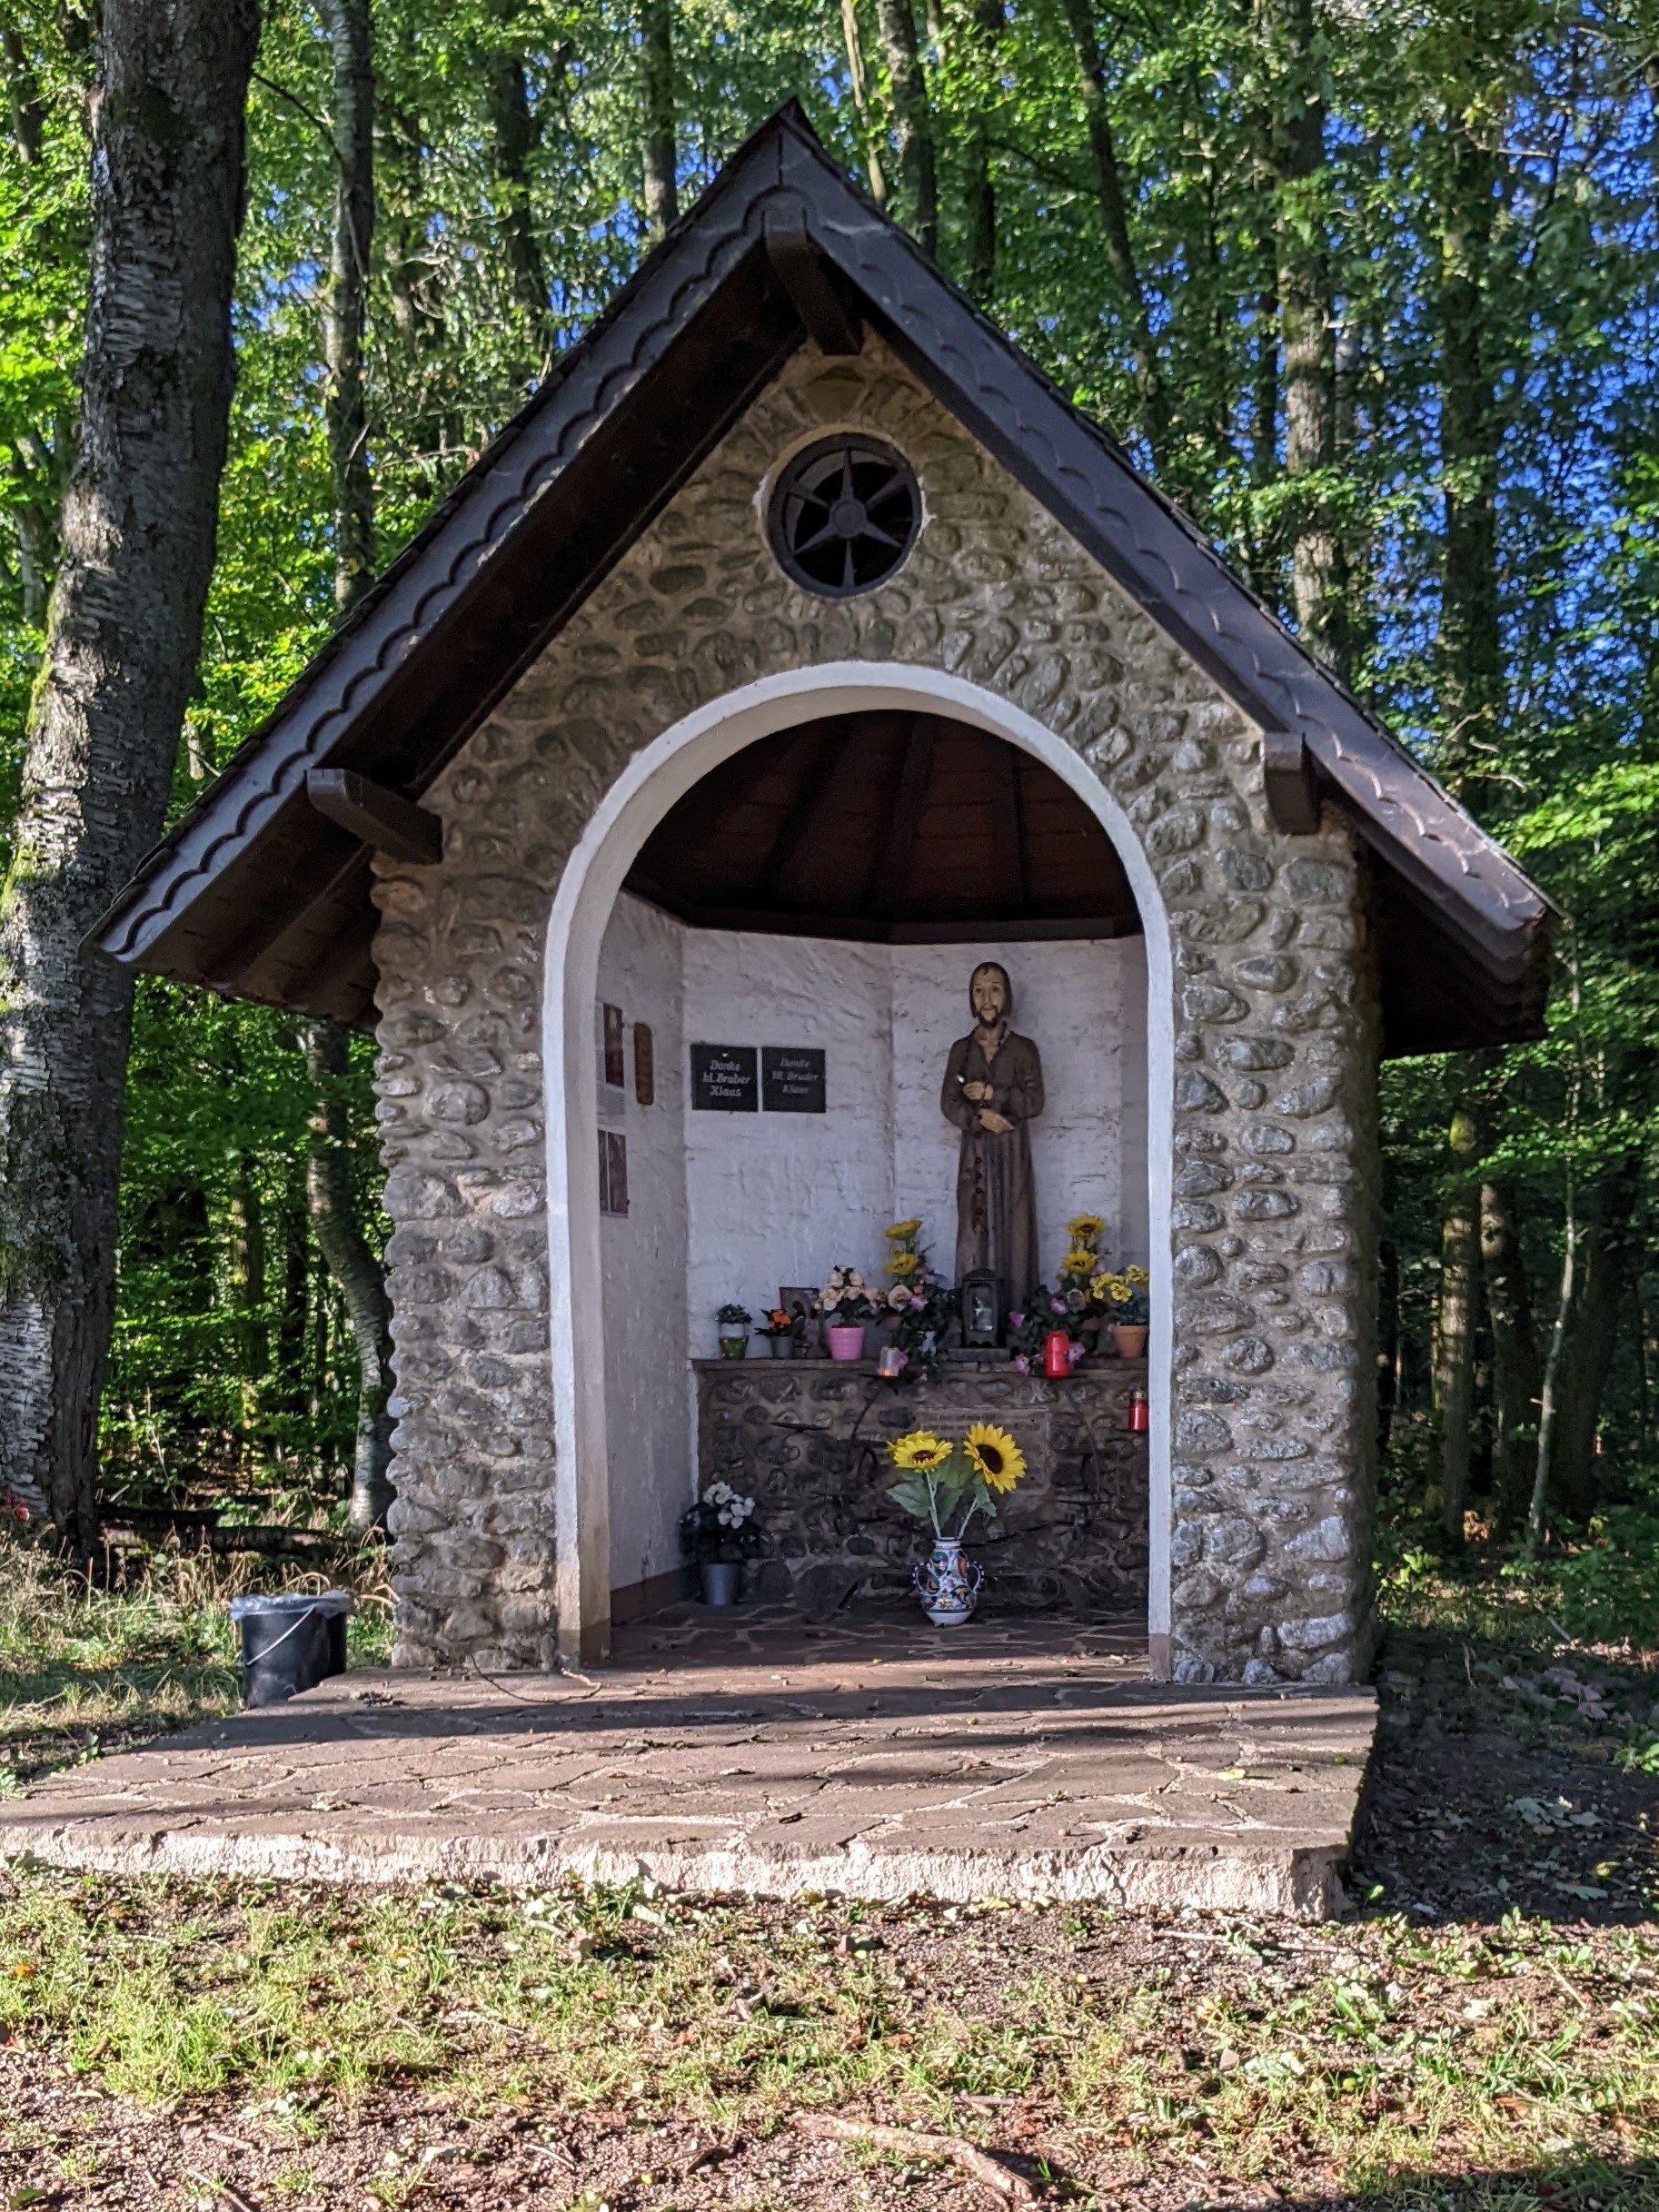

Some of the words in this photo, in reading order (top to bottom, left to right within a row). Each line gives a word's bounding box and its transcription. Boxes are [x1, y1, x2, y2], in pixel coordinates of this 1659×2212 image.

[710, 1059, 740, 1071] Danke
[780, 1057, 810, 1068] Danke
[787, 1071, 820, 1082] Bruder
[710, 1085, 742, 1097] Klaus
[782, 1084, 810, 1094] Klaus
